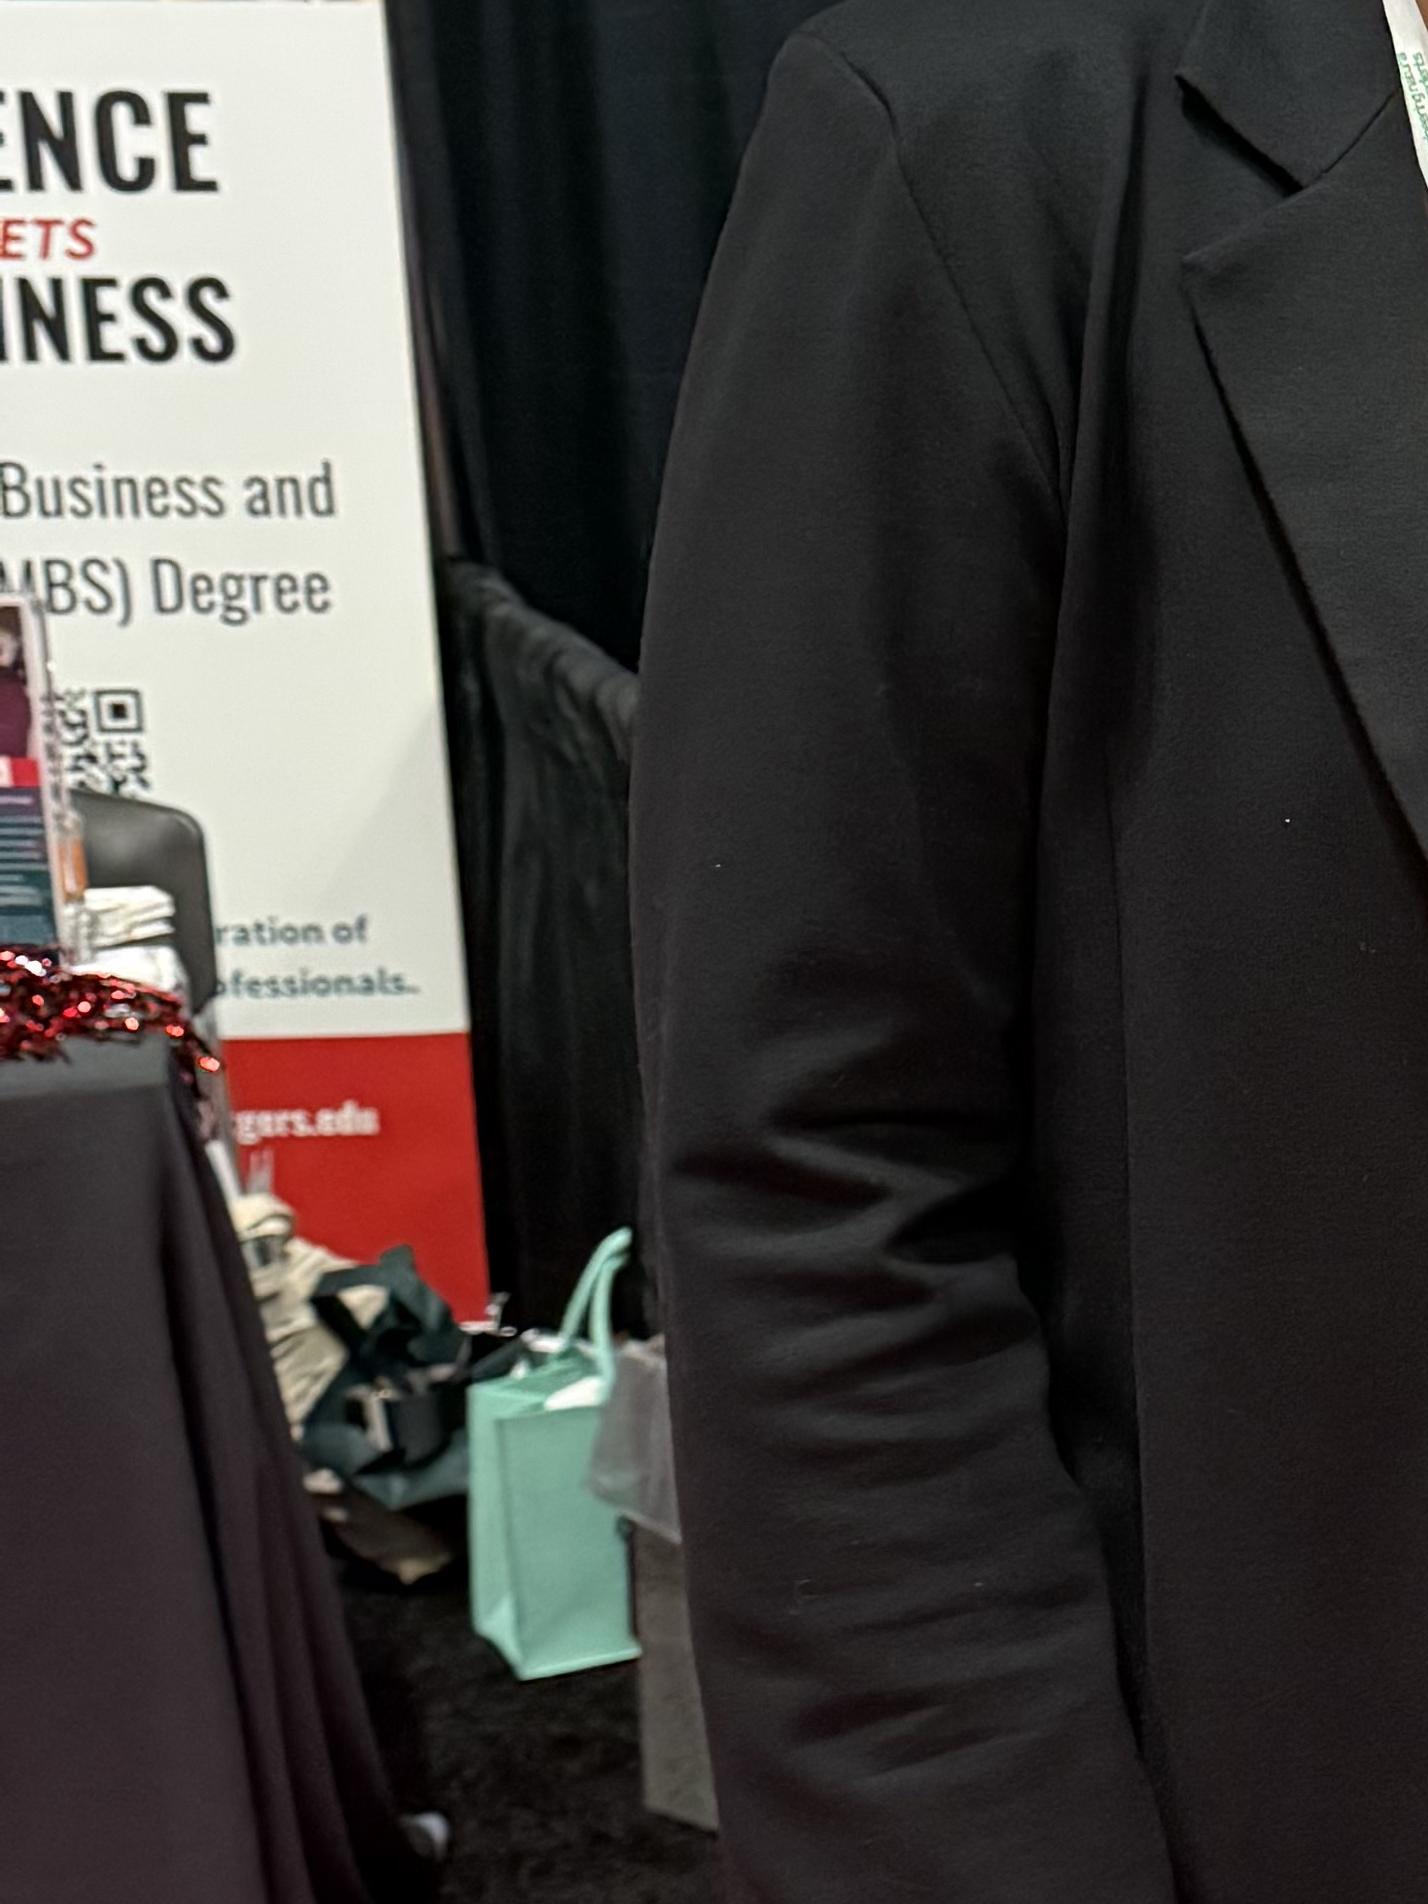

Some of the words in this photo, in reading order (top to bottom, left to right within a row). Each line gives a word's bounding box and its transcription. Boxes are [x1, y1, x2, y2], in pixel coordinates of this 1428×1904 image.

[0, 91, 218, 192] NCE
[1, 461, 227, 518] Business
[244, 458, 336, 517] and
[151, 558, 332, 626] Degree
[332, 913, 369, 944] of
